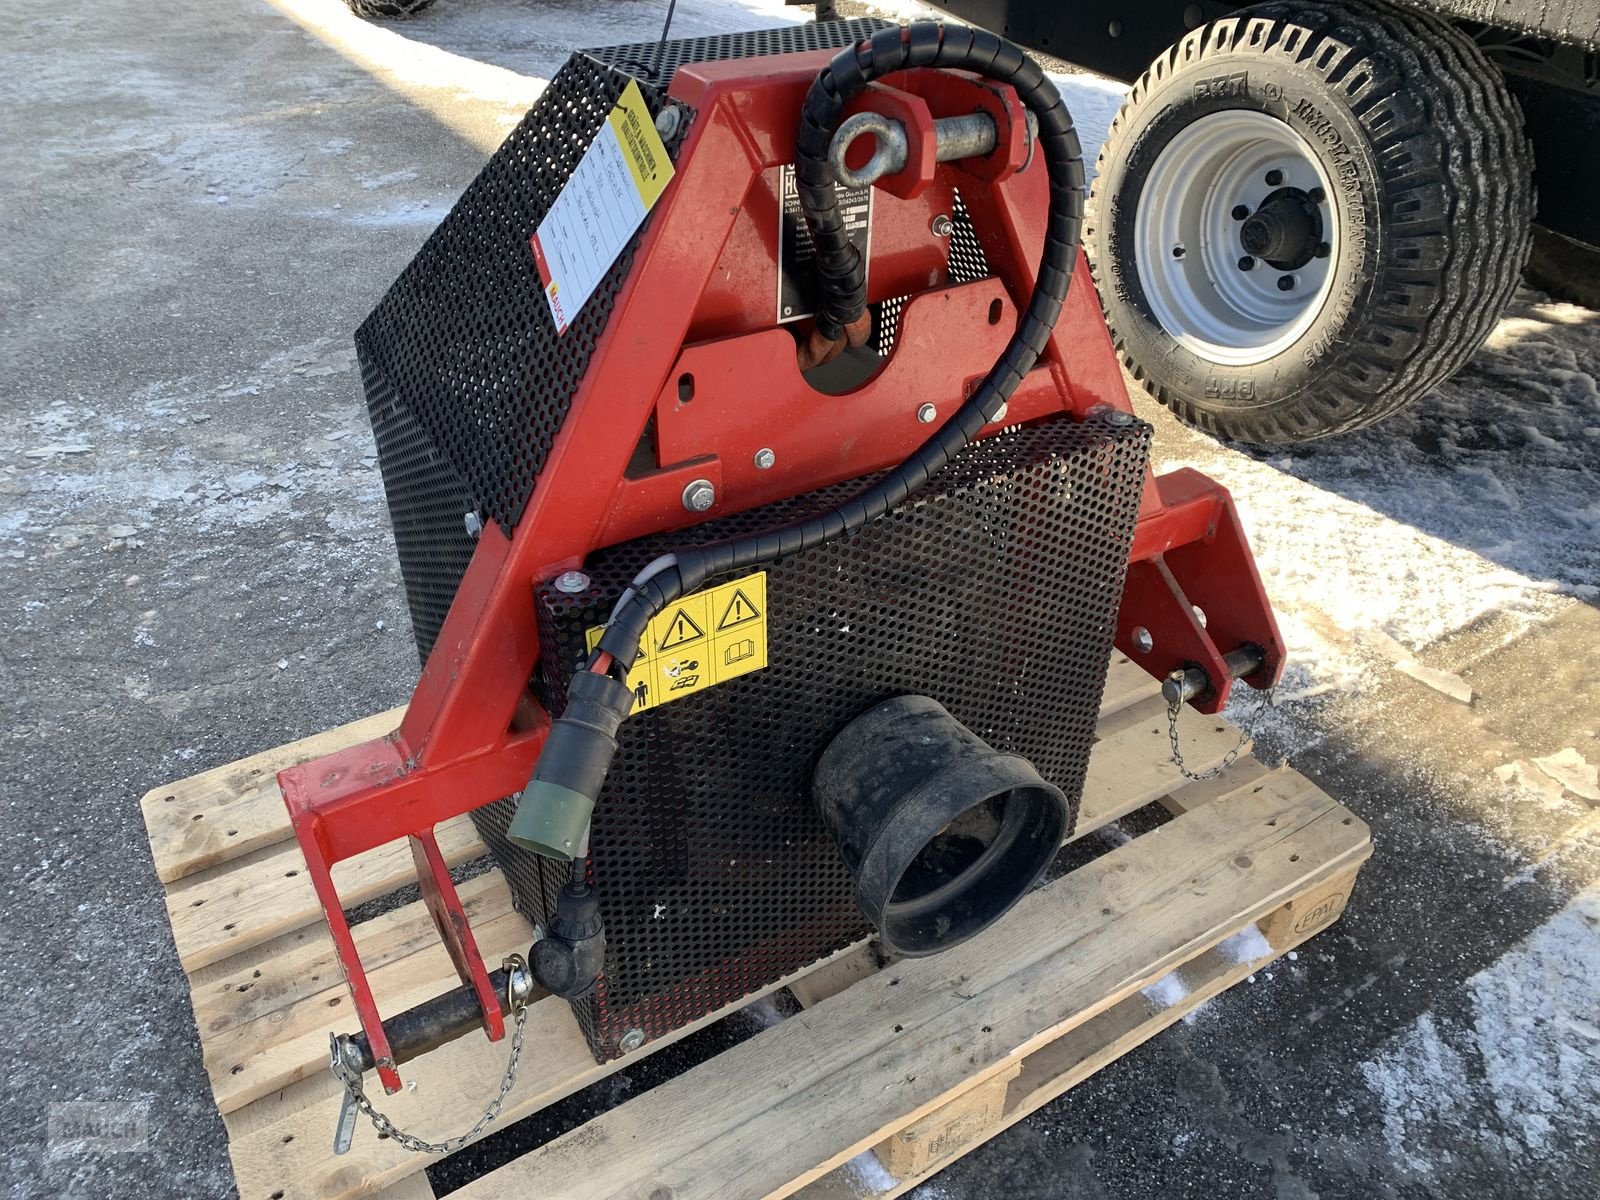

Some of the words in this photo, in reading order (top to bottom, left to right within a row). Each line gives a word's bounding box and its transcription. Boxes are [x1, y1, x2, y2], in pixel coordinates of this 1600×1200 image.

[1194, 74, 1247, 101] BKT
[625, 105, 641, 135] GERÄTE
[637, 133, 657, 173] MASCHINEN
[548, 285, 565, 326] MAUCH
[1205, 376, 1254, 398] BKT
